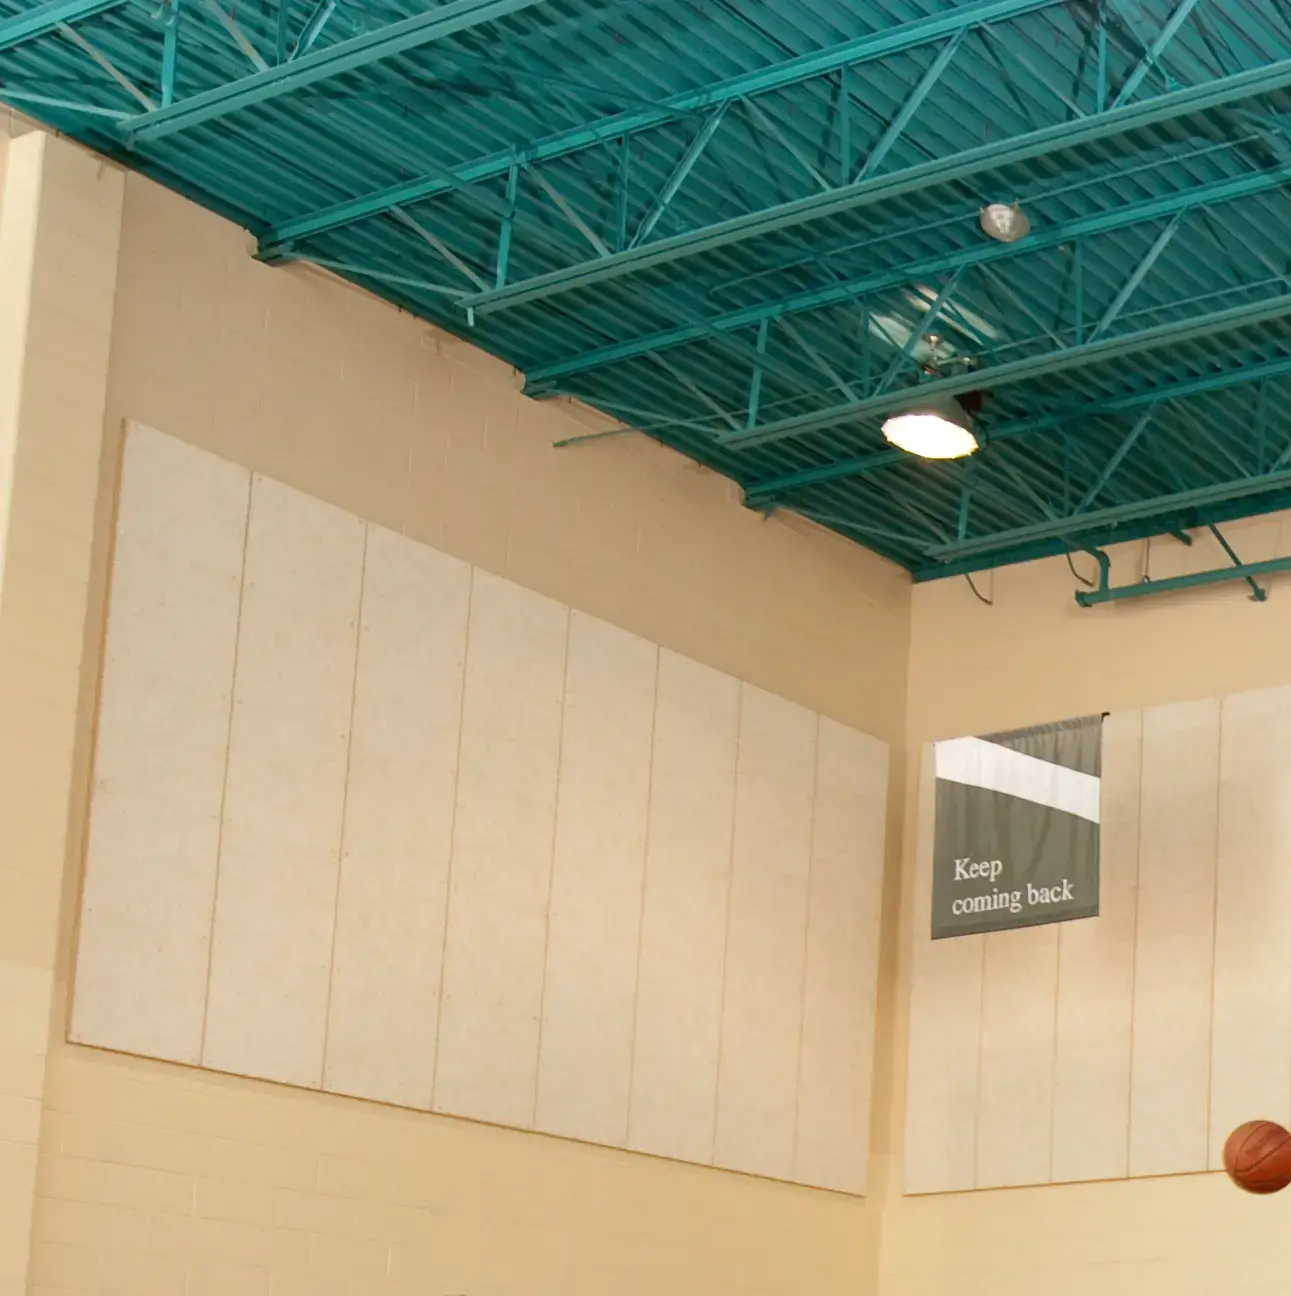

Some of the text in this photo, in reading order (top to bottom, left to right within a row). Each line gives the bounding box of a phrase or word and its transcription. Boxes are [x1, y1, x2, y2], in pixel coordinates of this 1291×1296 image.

[954, 858, 1002, 881] Keep
[952, 879, 1073, 914] coming back
